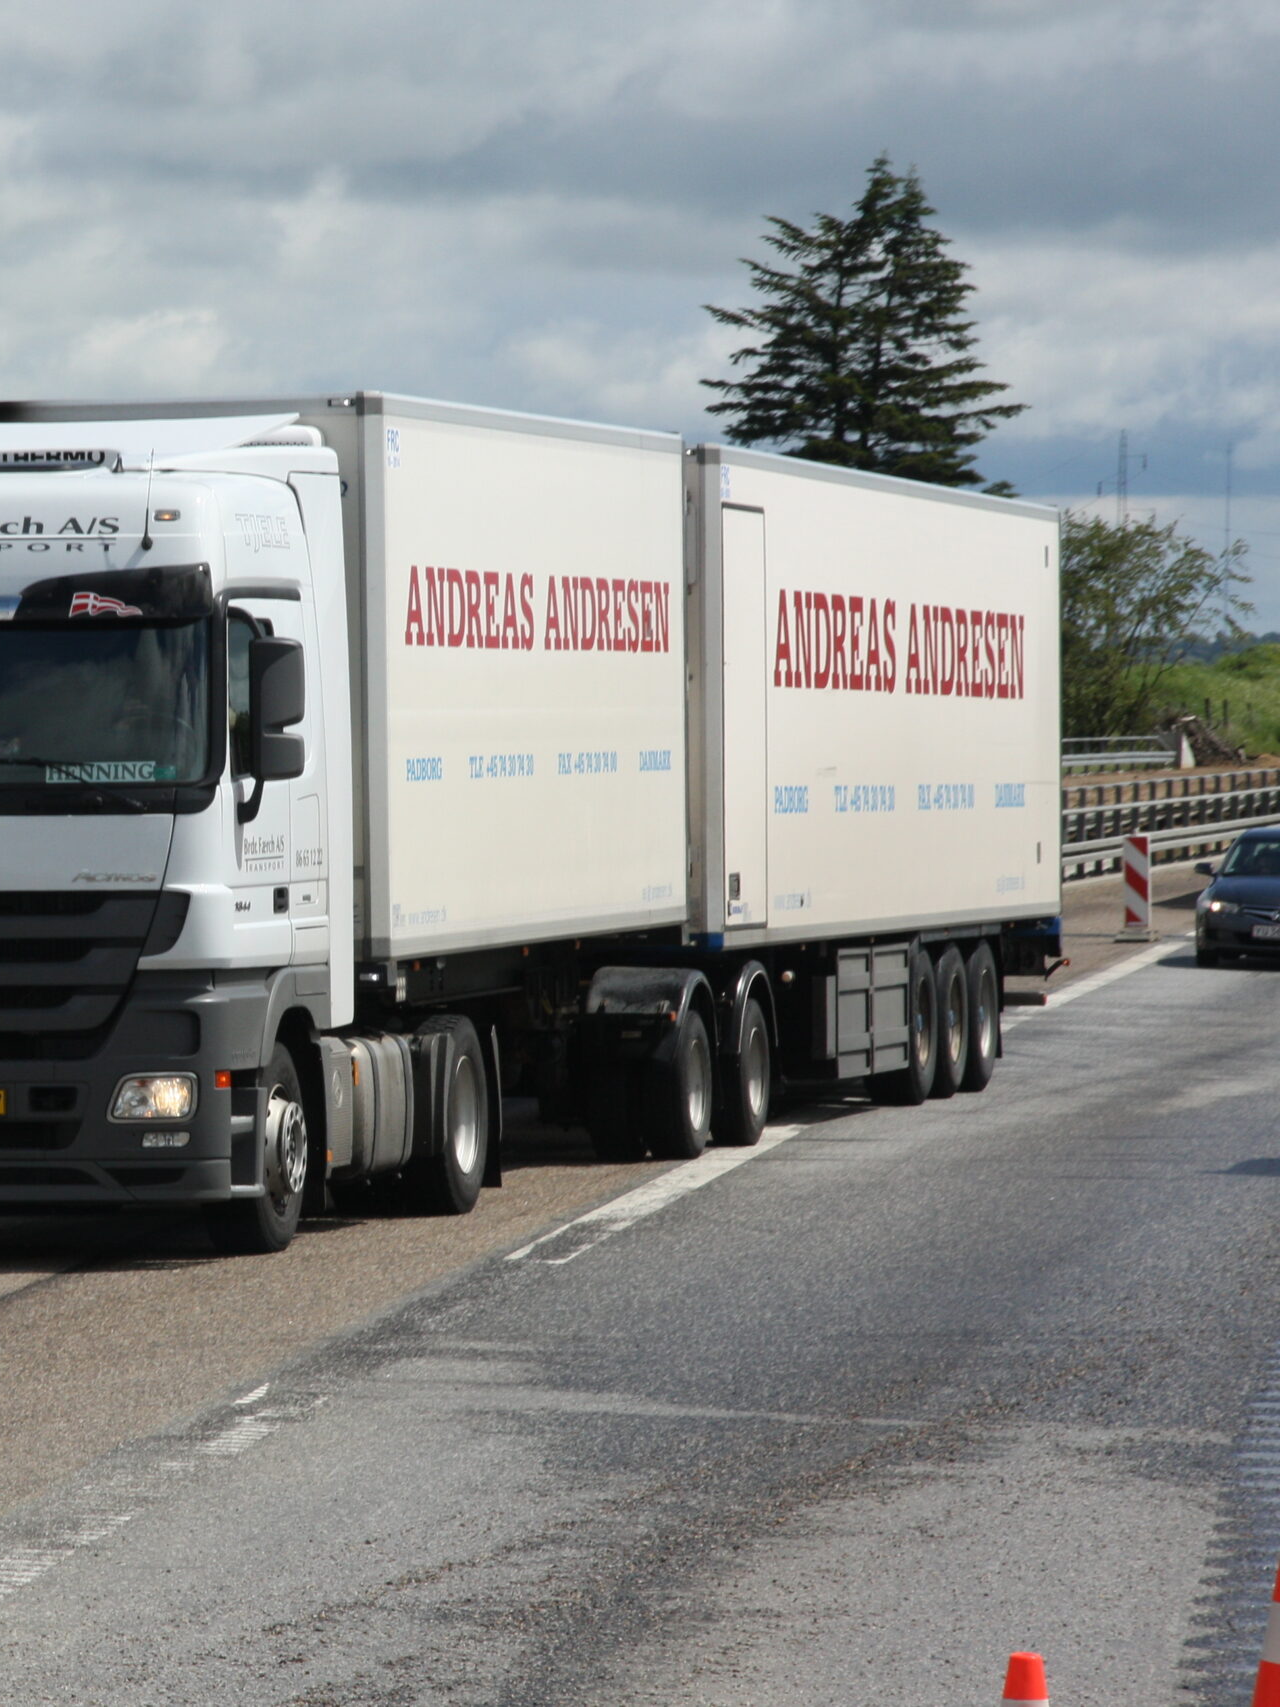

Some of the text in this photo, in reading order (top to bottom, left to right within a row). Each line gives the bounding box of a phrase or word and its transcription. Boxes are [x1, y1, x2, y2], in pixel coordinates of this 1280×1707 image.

[57, 516, 120, 536] A/S
[405, 565, 670, 653] ANDREAS ANDRESEN
[774, 589, 1024, 700] ANDREAS ANDRESEN
[47, 763, 154, 781] HENNING
[406, 757, 442, 782] PADBORG
[486, 755, 498, 778] +45
[498, 755, 507, 777] 74
[508, 754, 517, 777] 30
[517, 754, 526, 776] 74
[558, 753, 572, 775] FAX
[574, 752, 585, 774] +45
[639, 750, 671, 771] DANMARK
[774, 786, 808, 813] PADBORG
[245, 860, 285, 872] TRANSPORT
